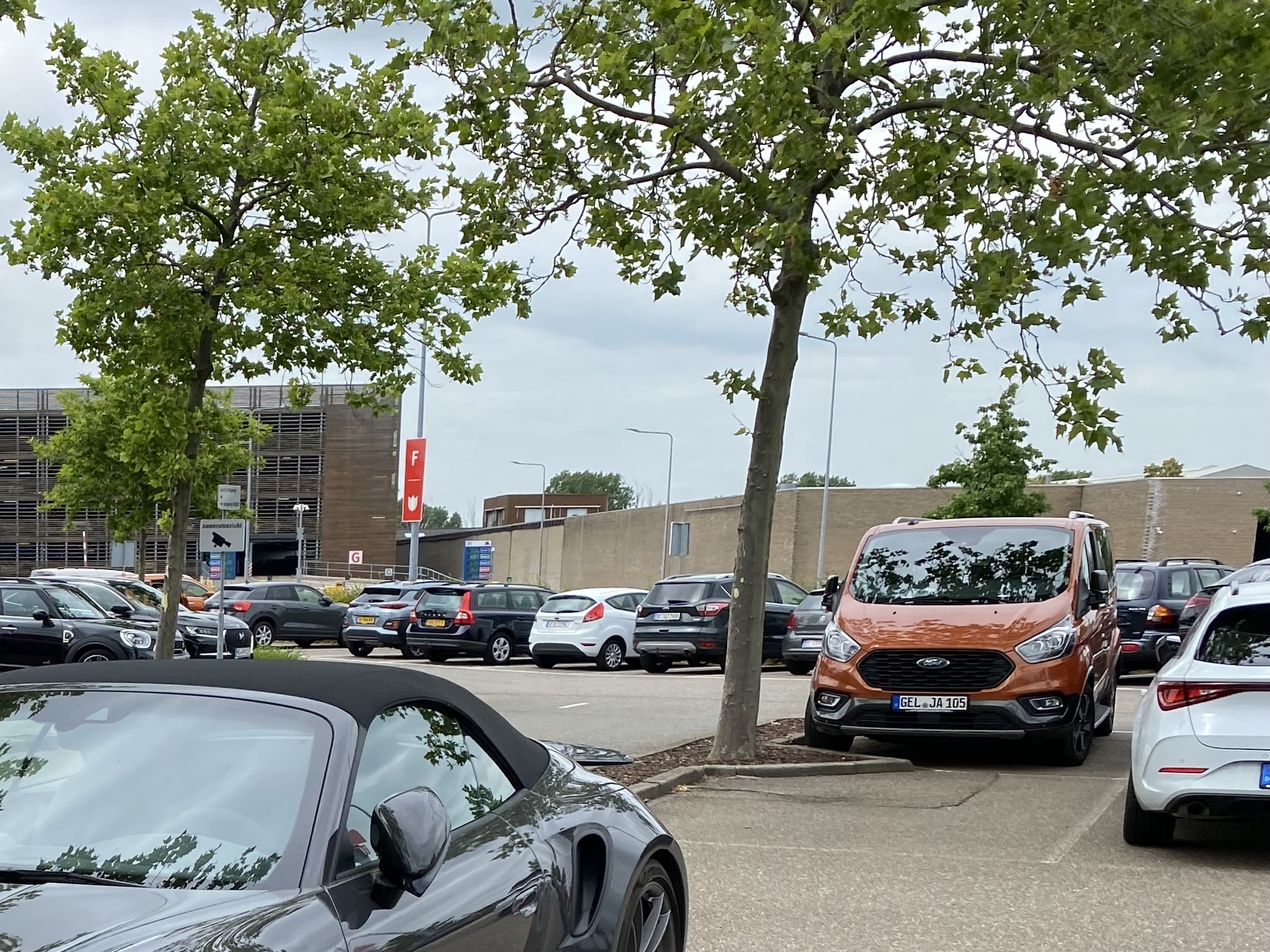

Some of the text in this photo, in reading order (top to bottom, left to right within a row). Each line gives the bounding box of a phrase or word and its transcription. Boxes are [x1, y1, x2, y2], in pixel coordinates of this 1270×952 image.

[411, 450, 420, 467] F
[351, 552, 360, 563] G
[900, 697, 966, 708] GEL JA 105
